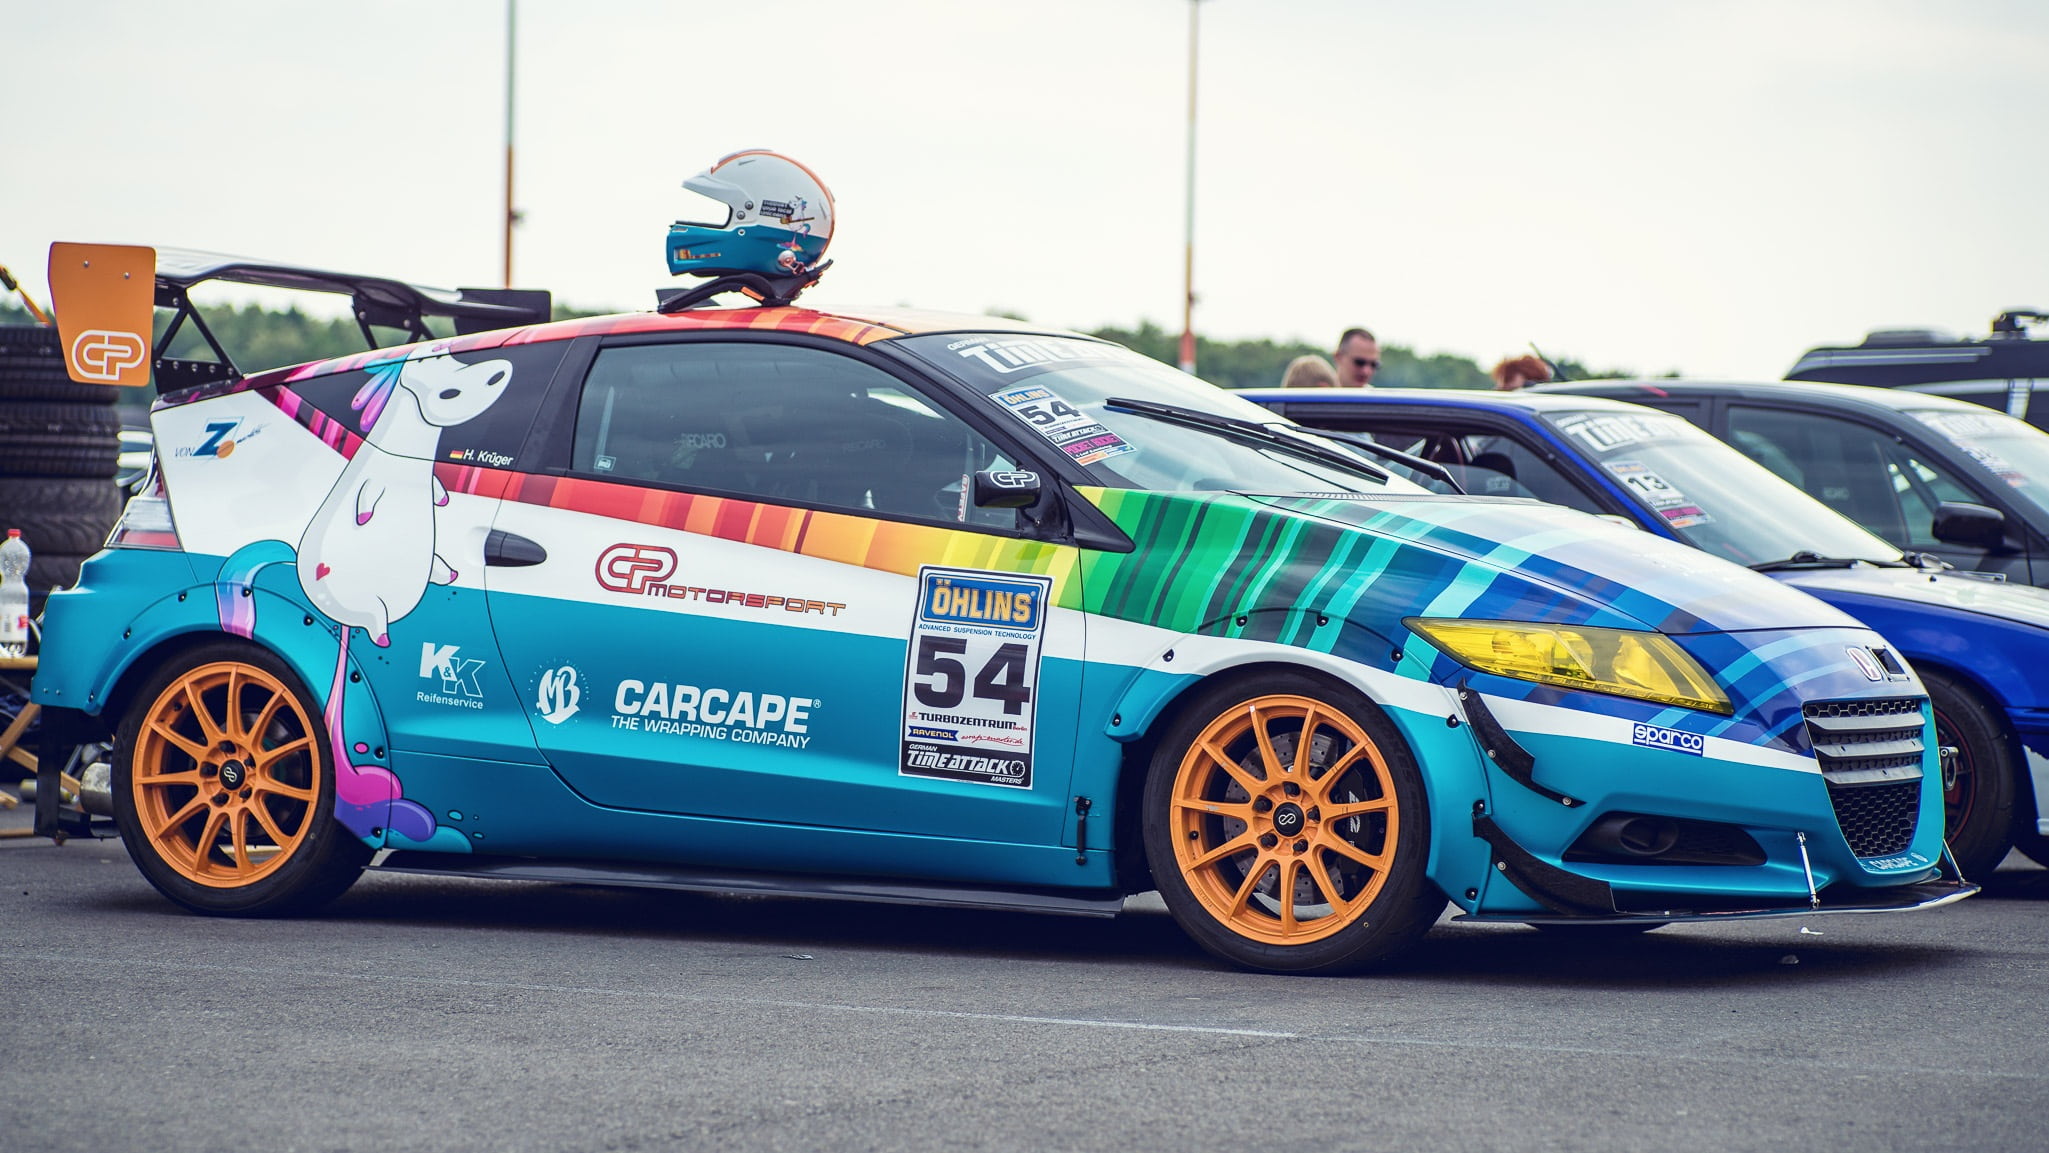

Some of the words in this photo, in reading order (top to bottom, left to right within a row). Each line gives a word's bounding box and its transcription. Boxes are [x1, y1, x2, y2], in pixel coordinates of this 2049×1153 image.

[1017, 400, 1081, 425] 54
[463, 449, 475, 460] H.
[477, 450, 514, 467] Krüger
[1627, 475, 1669, 491] 13
[648, 583, 846, 616] MOTORSPORT
[931, 578, 1032, 623] ÖHLINS
[918, 623, 951, 632] ADVANCED
[953, 626, 992, 636] SUSPENSION
[995, 630, 1036, 640] TECHNOLOGY
[913, 635, 1031, 715] 54
[416, 691, 484, 710] Reifenservice
[919, 712, 1017, 730] TURBOZENTRUM
[611, 715, 640, 731] THE
[644, 719, 727, 740] WRAPPING
[731, 729, 811, 749] COMPANY
[912, 728, 954, 739] RAVENOL
[1634, 725, 1703, 750] sparco
[909, 743, 938, 752] GERMAN
[990, 775, 1023, 785] MASTERS
